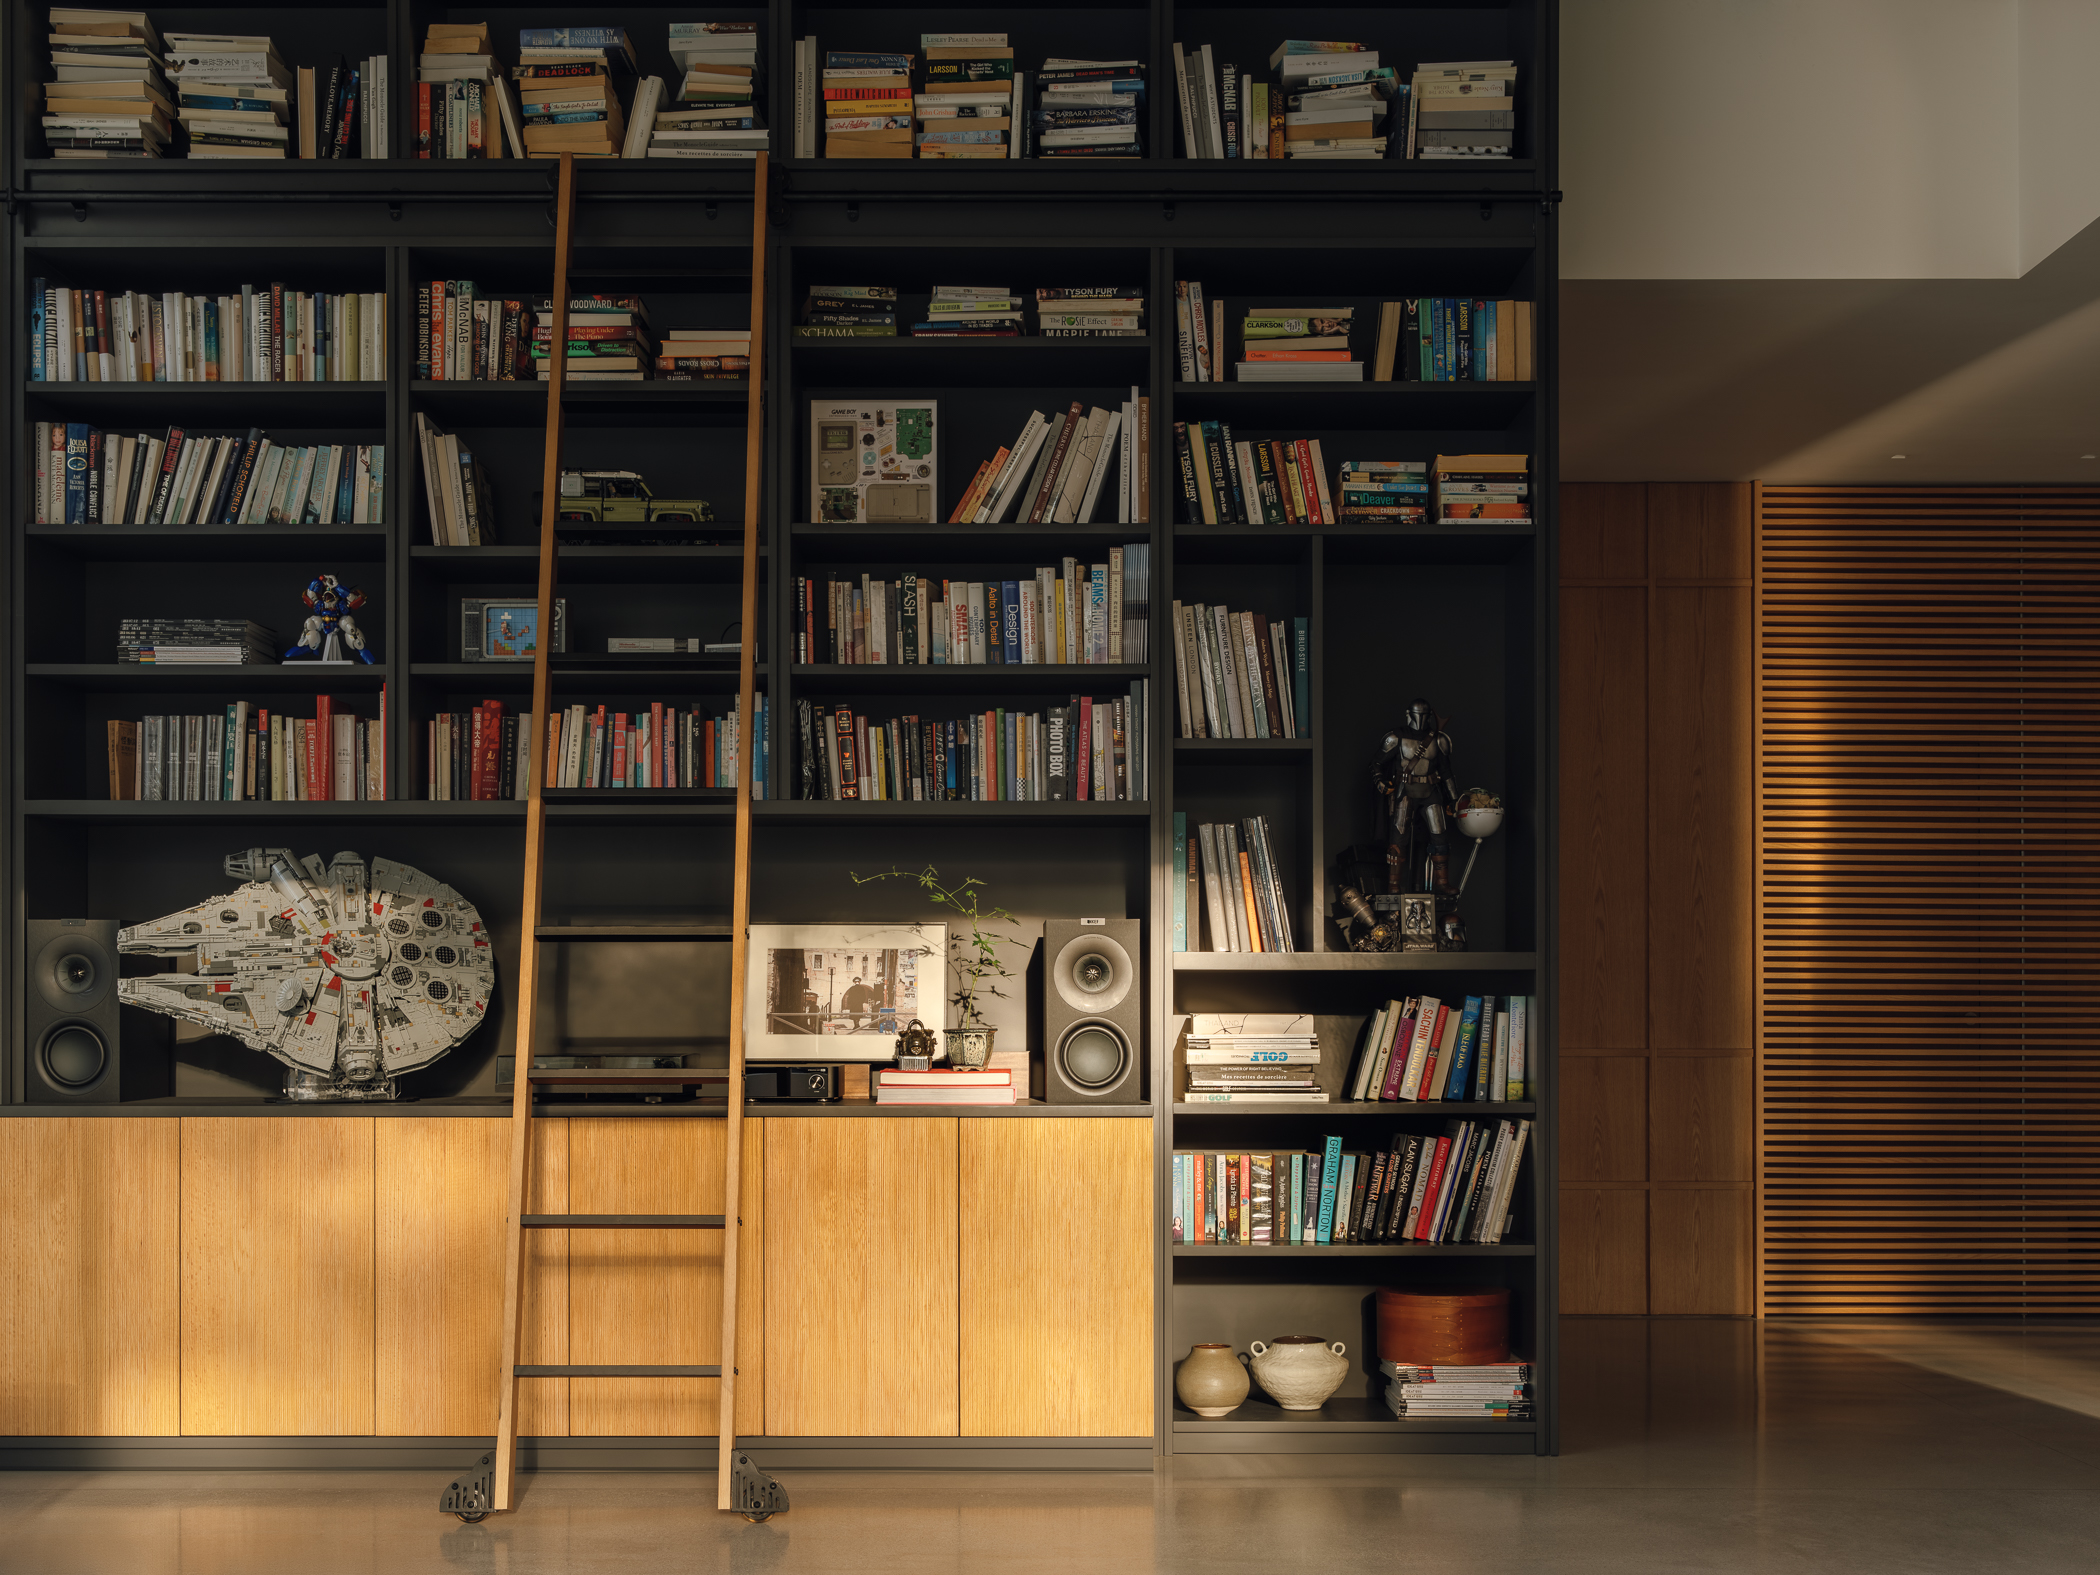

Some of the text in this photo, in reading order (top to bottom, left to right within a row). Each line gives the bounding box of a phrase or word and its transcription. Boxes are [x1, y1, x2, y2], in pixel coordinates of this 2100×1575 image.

[570, 35, 619, 47] WITH NO ONE
[929, 65, 958, 74] LARSSON
[1328, 72, 1362, 84] LISA JACKSON
[934, 109, 957, 117] Grisham
[1056, 109, 1117, 118] BARBARA ERSKINE
[1226, 121, 1236, 158] CRISIS FOUR
[431, 283, 443, 321] chris
[817, 300, 845, 308] GREY
[1459, 302, 1468, 331] LARSSON
[418, 288, 429, 361] PETER ROBINSON
[445, 301, 454, 360] TOM PARKER Hope
[458, 301, 469, 343] McNAB
[801, 328, 855, 337] SCHAMA
[1193, 302, 1206, 343] CHRIS MOYLES
[32, 333, 41, 369] ECLIPSE
[432, 333, 442, 377] evans
[678, 359, 720, 367] CROSS ROADS
[1179, 331, 1189, 373] SINFIELD
[1141, 403, 1148, 411] BY
[89, 434, 97, 468] blackman
[1222, 425, 1231, 440] IAN
[1225, 439, 1236, 470] RANKIN
[1257, 443, 1270, 472] LARSSON
[55, 457, 65, 503] madeleine
[89, 470, 99, 518] NOBLE CONFLICT
[229, 440, 257, 513] PHILLIP SCHOFIELD
[1182, 449, 1198, 503] TYSON FURY
[1233, 487, 1241, 502] Open
[1363, 492, 1395, 506] Deaver
[903, 574, 917, 617] SLASH
[1092, 570, 1104, 603] BEAMS
[955, 604, 968, 646] SMALL
[988, 586, 1000, 646] Aalto in Detail
[1005, 604, 1020, 646] Design
[1185, 613, 1197, 675] UNSEEN LONDON
[1218, 614, 1232, 675] FURNITURE DESIGN
[924, 725, 933, 774] BEYOND ORDER
[1049, 717, 1064, 778] PHOTO BOX
[1079, 758, 1087, 783] BEAUTY
[1188, 838, 1196, 875] WANIMAL
[1394, 1019, 1408, 1058] OSBOURNE
[1510, 1001, 1518, 1039] Montefiore
[1250, 1051, 1289, 1062] GOLF
[1406, 1008, 1433, 1088] SACHIN TENDULKAR
[1456, 1032, 1472, 1069] ISLE OF DOGS
[1478, 1002, 1492, 1084] BATTLE READY OLLIE OLLERTON
[1390, 1059, 1403, 1086] EXTREME
[1469, 1131, 1479, 1150] MARC
[1229, 1169, 1237, 1183] Lynda
[1430, 1143, 1448, 1189] Kate Garraway
[1463, 1149, 1475, 1173] JACOBS
[1320, 1140, 1340, 1233] GRAHAM NORTON
[1367, 1165, 1385, 1201] RIFTWAR
[1392, 1139, 1417, 1228] ALAN SUGAR UNSCRIPTED
[1414, 1163, 1430, 1201] NOMAD
